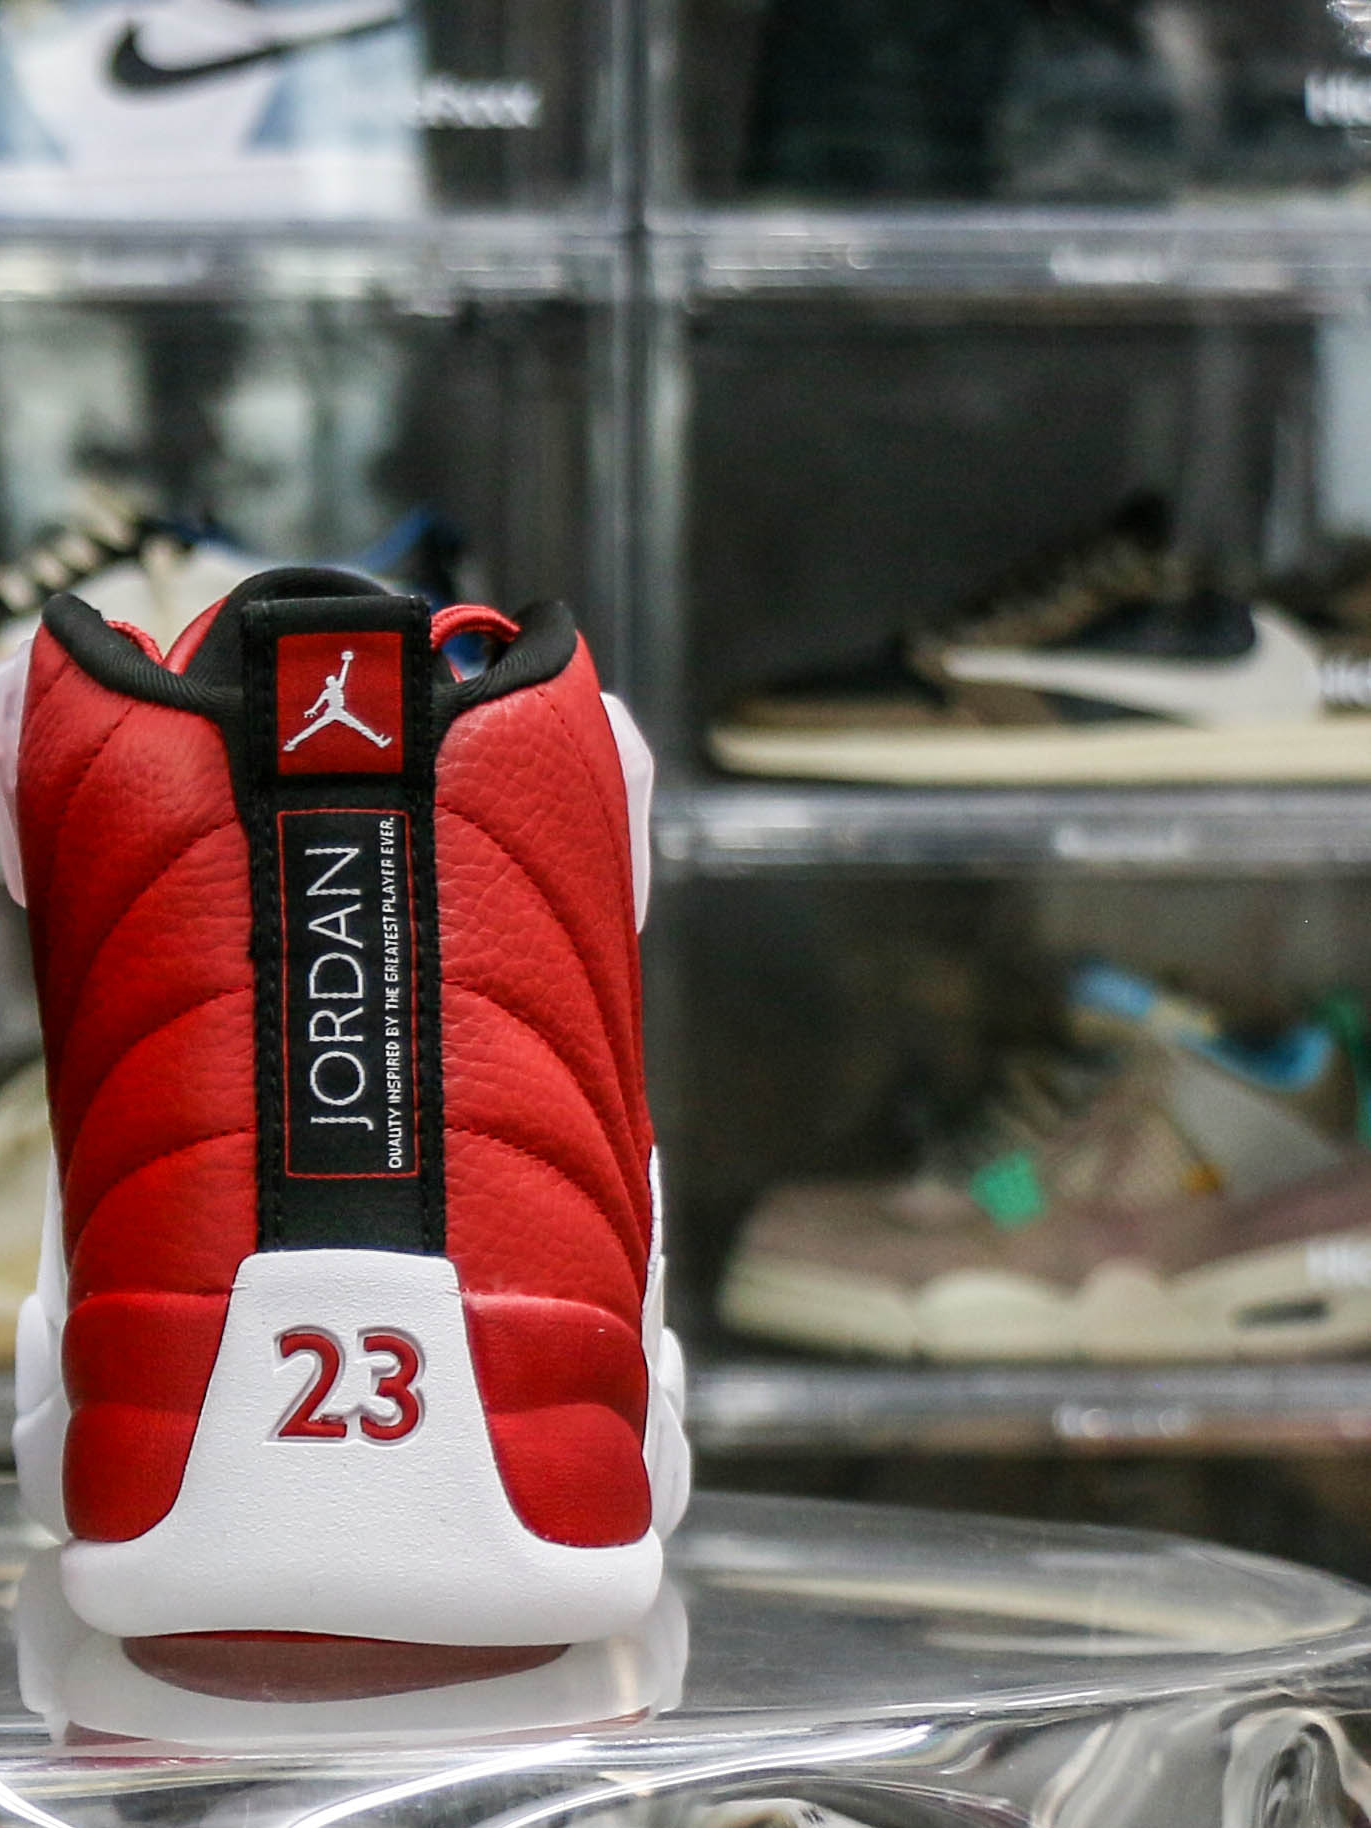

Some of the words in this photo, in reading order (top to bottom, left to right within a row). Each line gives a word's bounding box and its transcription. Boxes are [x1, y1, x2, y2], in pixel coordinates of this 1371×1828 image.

[379, 816, 395, 855] EVER.
[380, 858, 397, 913] PLAYER
[381, 915, 400, 983] GREATEST
[305, 848, 374, 1130] JORDAN
[384, 986, 401, 1011] THE
[384, 1015, 400, 1037] BY
[384, 1040, 402, 1104] INSPIRED
[387, 1107, 403, 1169] QUALITY
[275, 1327, 424, 1443] 23
